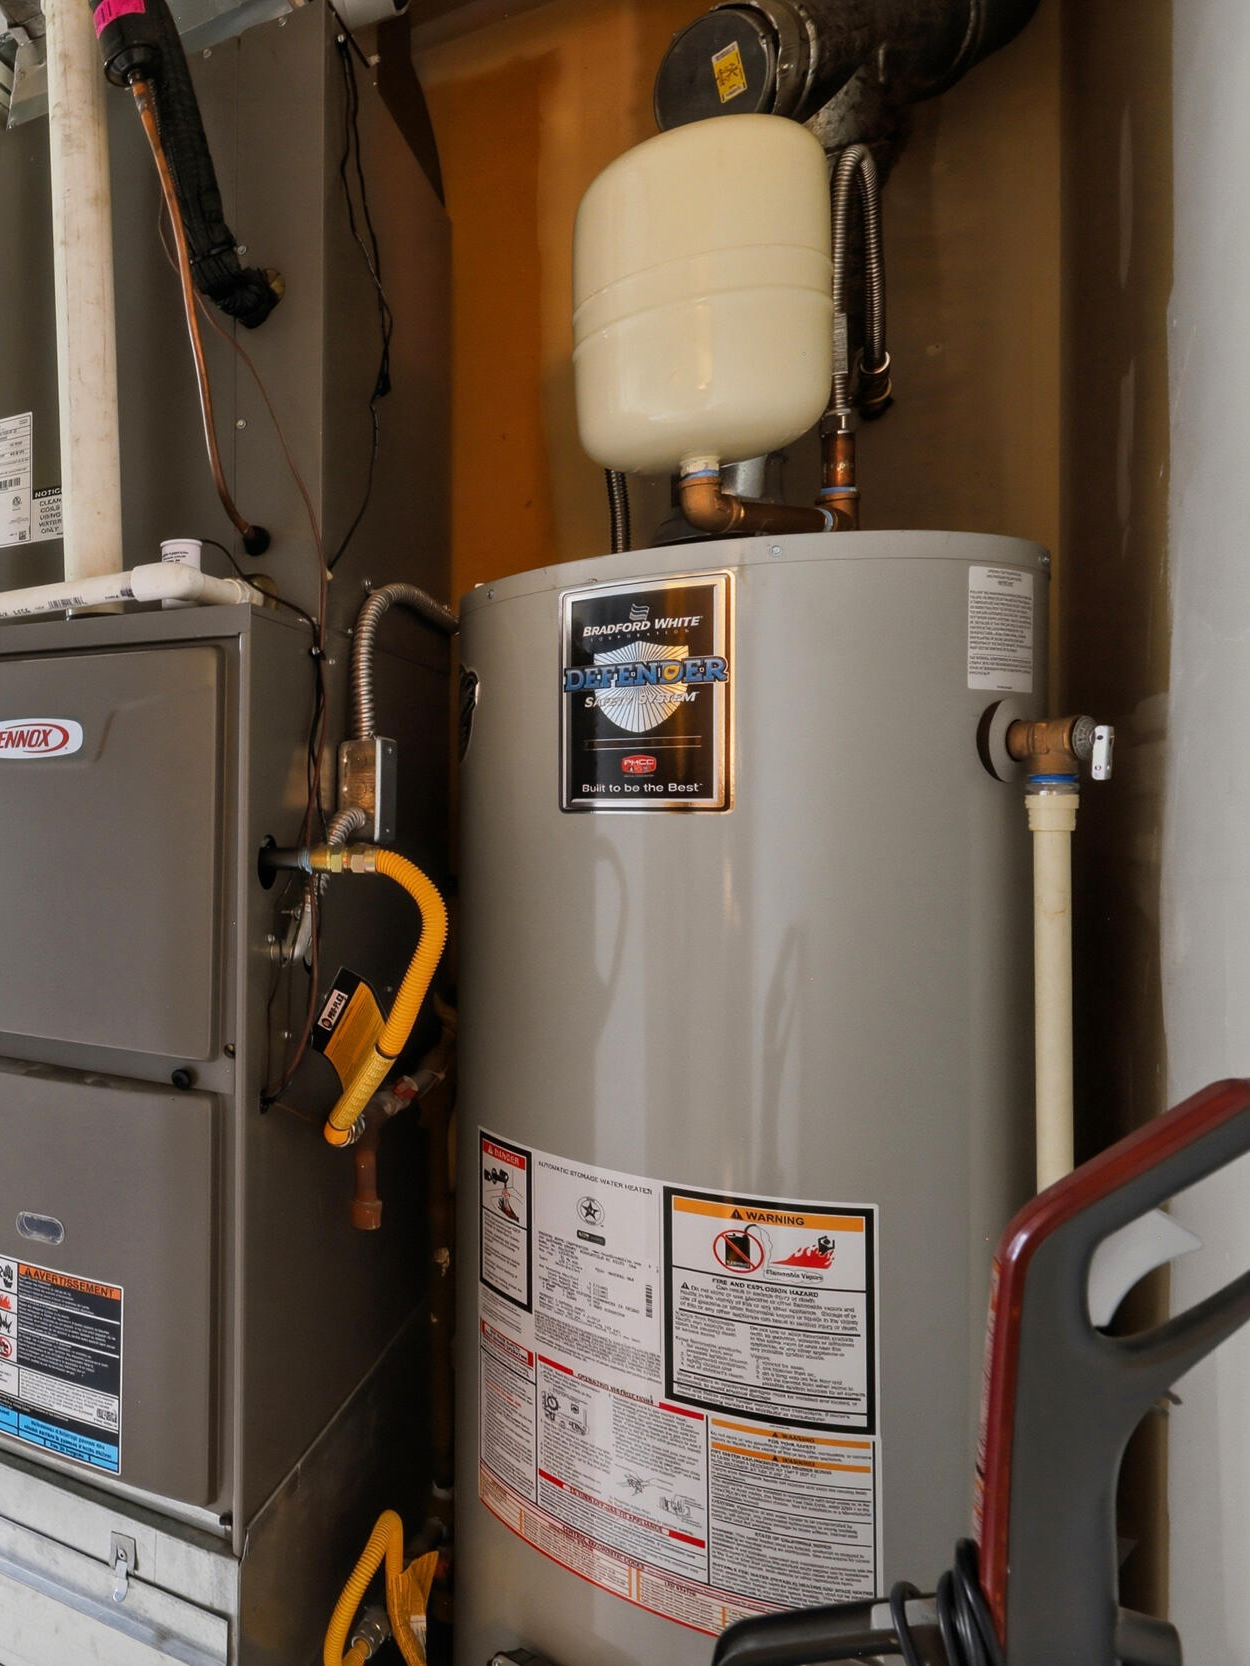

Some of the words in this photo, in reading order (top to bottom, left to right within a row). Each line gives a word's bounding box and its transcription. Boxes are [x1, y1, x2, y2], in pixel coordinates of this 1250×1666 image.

[34, 487, 61, 498] NOTIC
[39, 498, 62, 507] CLEAN
[583, 620, 651, 637] BRADFORD
[654, 615, 701, 629] WHITE
[565, 656, 728, 692] DEFENDER
[638, 691, 697, 705] SYSTEM
[582, 783, 606, 793] Built
[608, 784, 621, 793] to
[624, 783, 640, 793] be
[644, 783, 664, 792] the
[668, 782, 699, 792] Best
[538, 1161, 569, 1175] AUTOMATIC
[570, 1170, 598, 1183] STORAGE
[600, 1178, 623, 1189] WATER
[624, 1184, 653, 1195] HEATER
[745, 1211, 805, 1226] WARNING
[33, 1268, 114, 1298] AVERTISSEMENT
[801, 1273, 823, 1281] Vapors
[712, 1278, 728, 1286] FIRE
[789, 1289, 819, 1298] HAZARD
